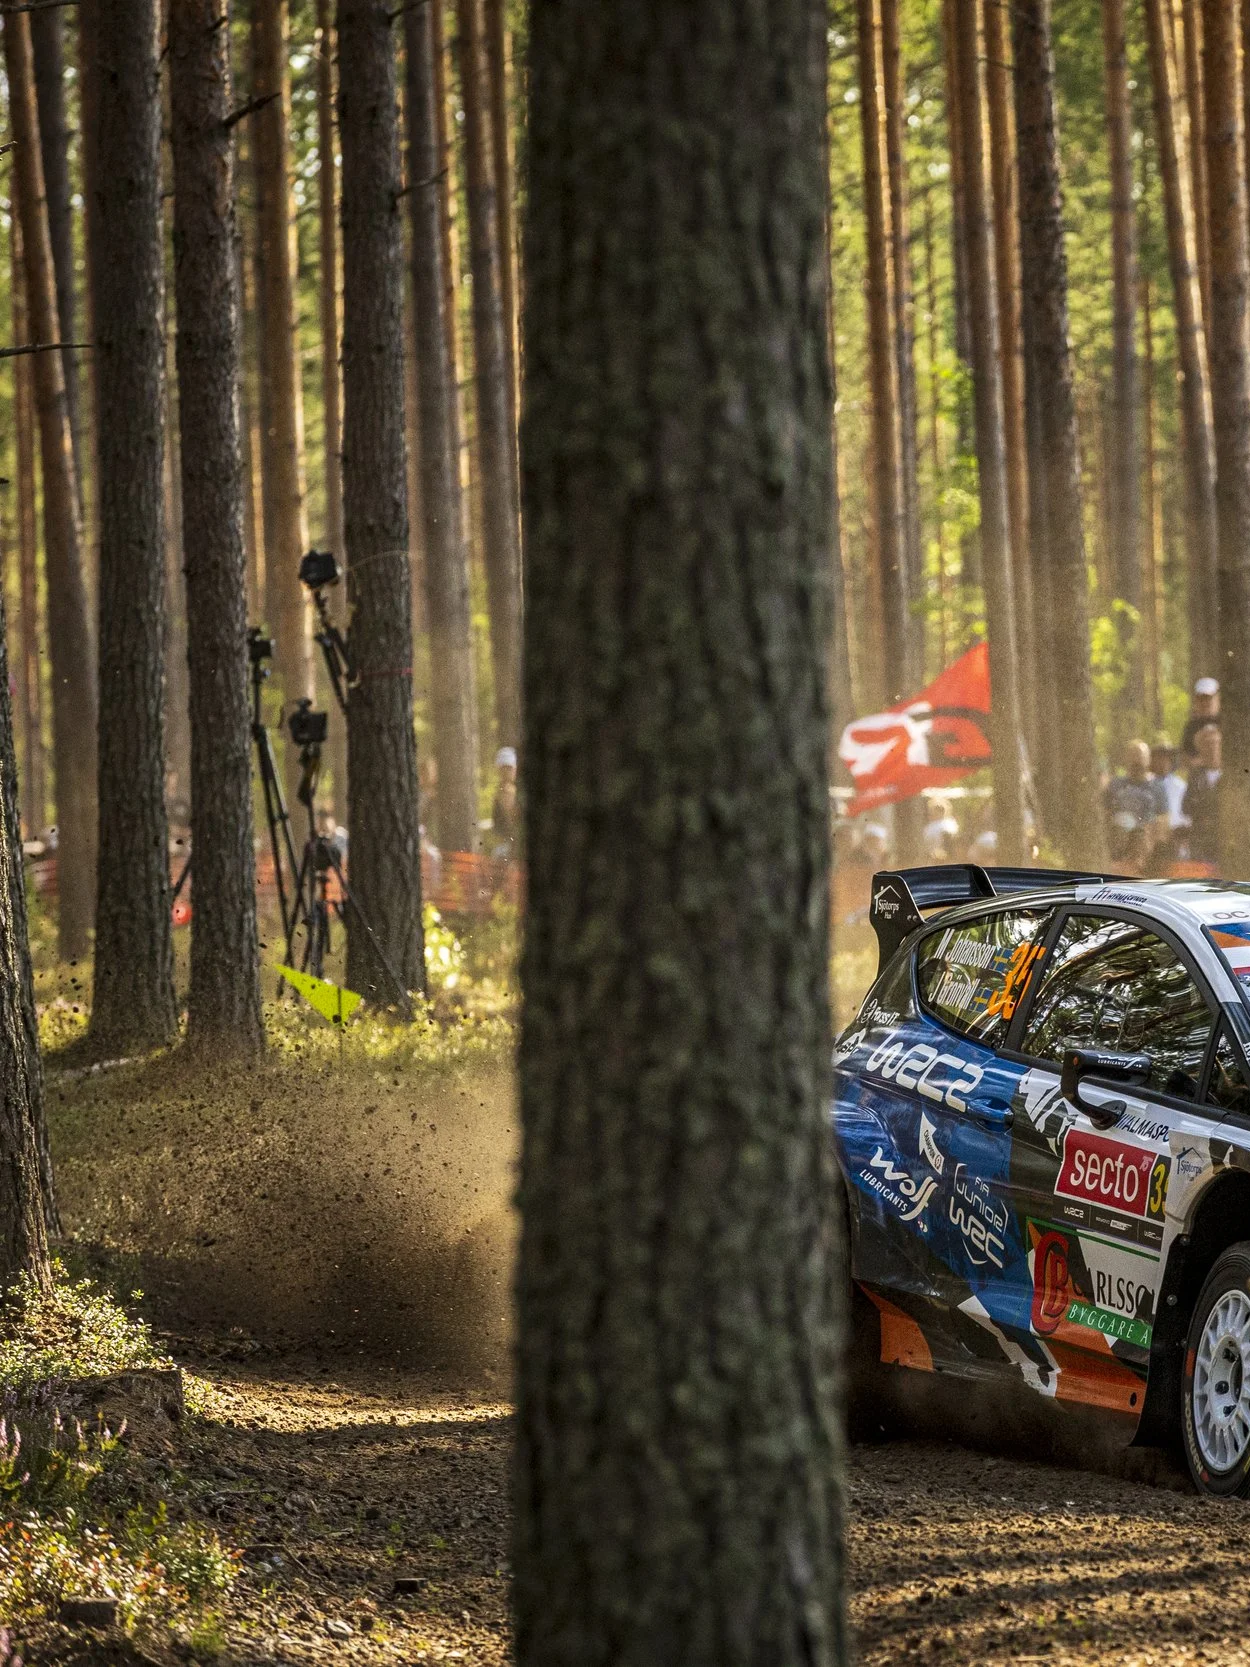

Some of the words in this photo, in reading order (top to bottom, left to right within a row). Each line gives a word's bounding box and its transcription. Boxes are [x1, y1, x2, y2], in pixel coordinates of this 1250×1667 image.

[933, 927, 955, 959] M
[945, 930, 997, 969] Johansson
[927, 970, 946, 1002] J
[936, 972, 980, 1010] Grönvall
[859, 1168, 909, 1212] LUBRICANTS
[974, 1176, 990, 1197] FIA
[1070, 1149, 1140, 1203] secto
[1149, 1163, 1170, 1216] 3
[1069, 1304, 1134, 1339] BYGGARE
